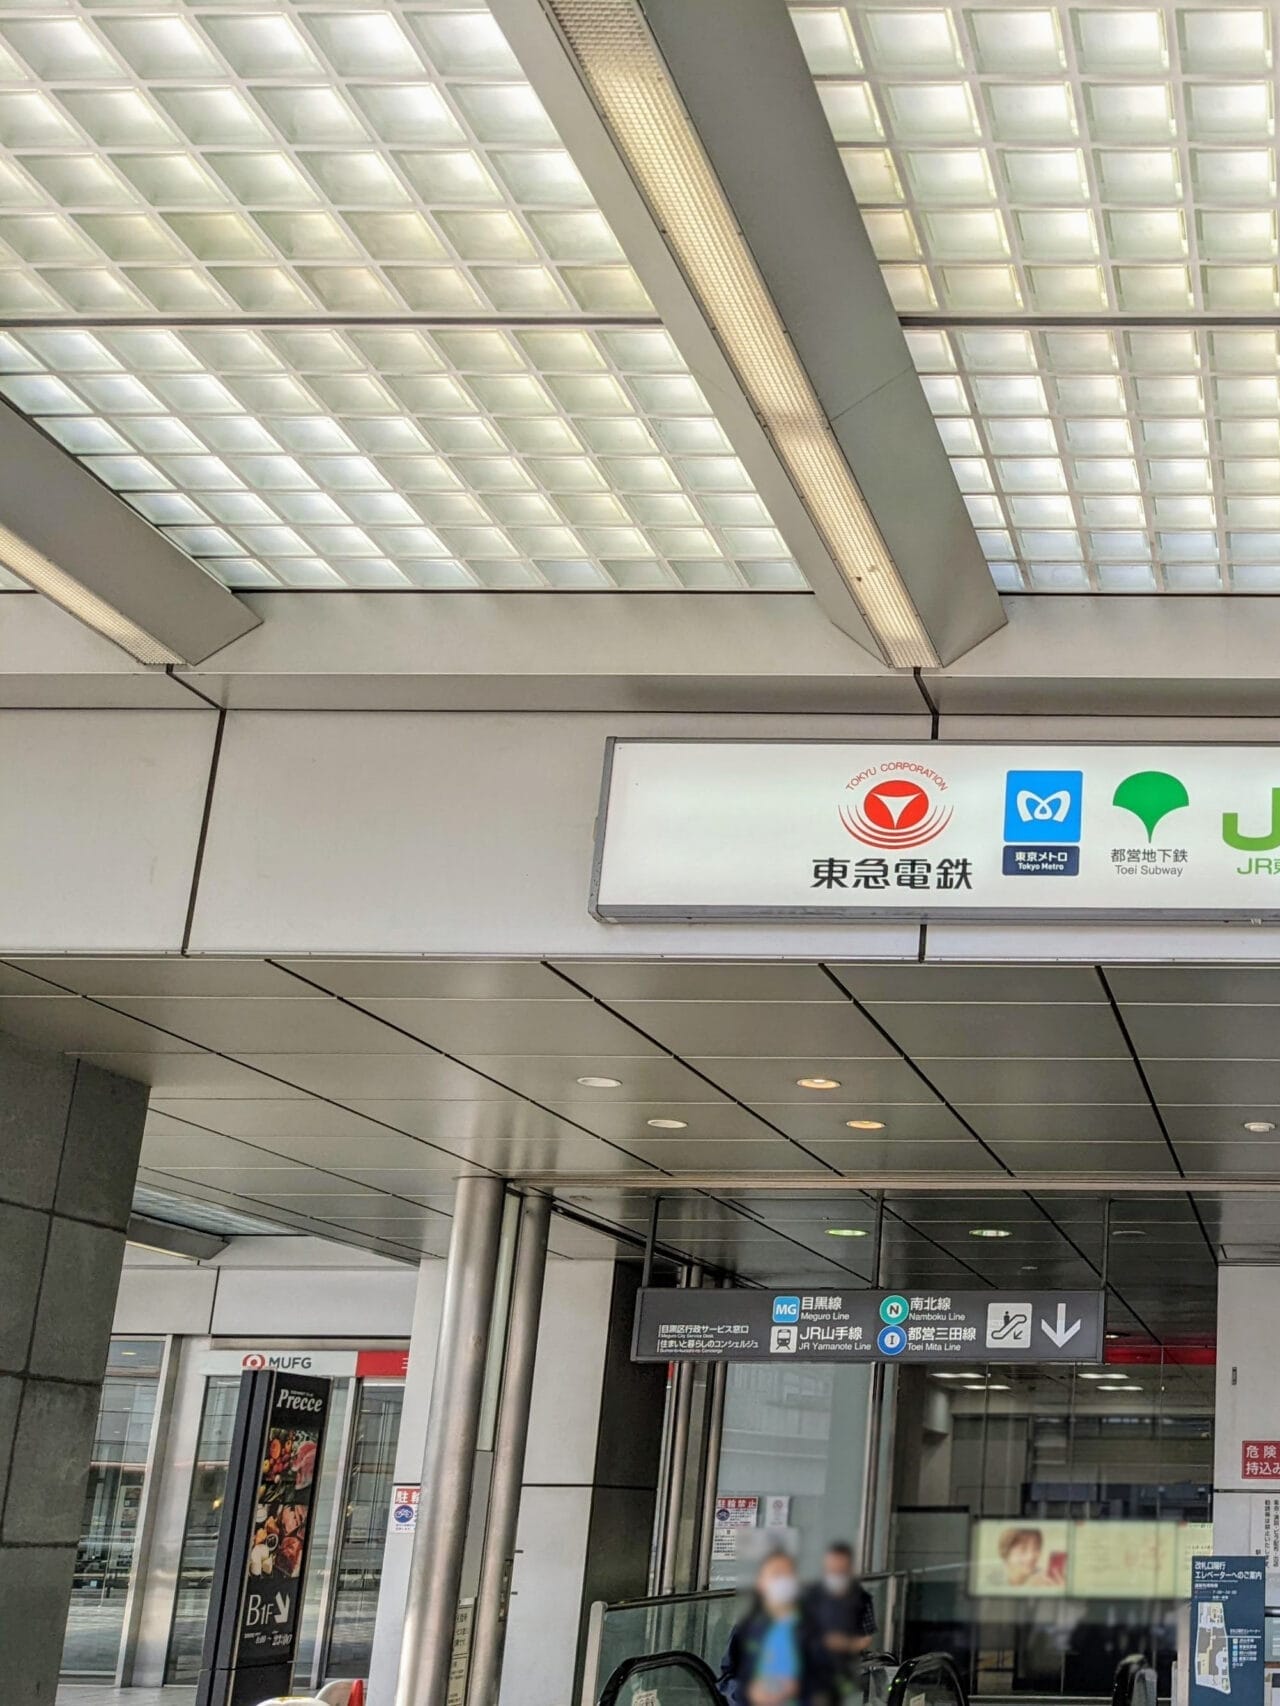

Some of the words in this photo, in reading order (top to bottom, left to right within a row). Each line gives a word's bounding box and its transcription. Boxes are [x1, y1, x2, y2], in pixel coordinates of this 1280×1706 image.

[845, 767, 877, 791] TOKYU
[880, 761, 949, 791] CORPORATION
[1015, 851, 1068, 862] 東京メトロ
[1111, 848, 1188, 864] 都営地下鉄
[1018, 862, 1040, 871] Tokyo
[1042, 862, 1064, 870] Metro
[1115, 865, 1137, 875] Toei
[1140, 865, 1183, 878] Subway
[811, 857, 973, 890] 東急電鉄
[775, 1304, 797, 1315] MG
[801, 1297, 842, 1310] 目黒線
[910, 1297, 951, 1310] 南北線
[889, 1305, 899, 1315] N
[801, 1312, 832, 1321] Meguro
[835, 1312, 850, 1320] Line
[948, 1313, 966, 1321] Line
[661, 1324, 749, 1334] 目黒区行政サービス窓口
[800, 1326, 863, 1340] JR山手線
[908, 1327, 976, 1341] 都営三田線
[660, 1340, 759, 1348] 住まいと暮らしのコンシェルジュ
[799, 1342, 810, 1350] JR
[812, 1342, 853, 1350] Yamanote
[908, 1343, 923, 1351] Toei
[925, 1343, 942, 1351] Mita
[944, 1343, 961, 1351] Line
[268, 1357, 312, 1369] MUFG
[276, 1389, 323, 1412] Precce
[246, 1594, 274, 1626] B1F
